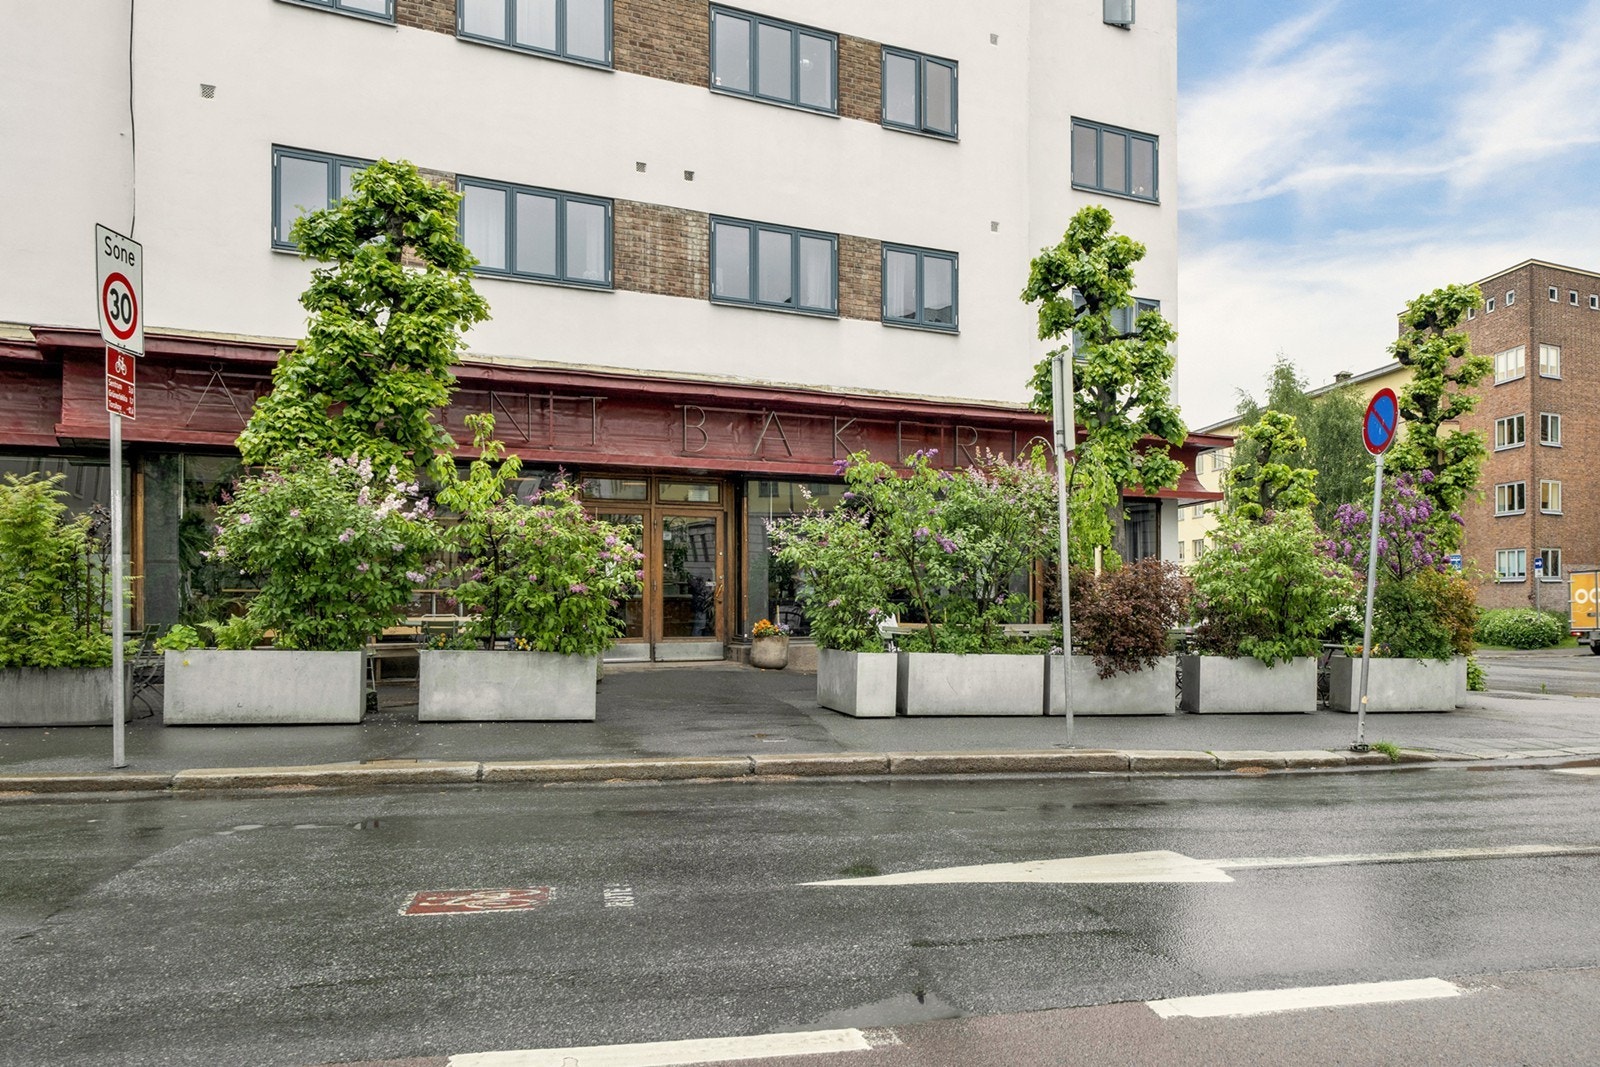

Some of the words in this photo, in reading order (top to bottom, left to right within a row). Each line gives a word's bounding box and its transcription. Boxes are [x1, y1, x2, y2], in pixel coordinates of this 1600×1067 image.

[104, 235, 135, 267] Sone
[109, 287, 132, 325] 30
[683, 404, 1017, 470] BAKERI
